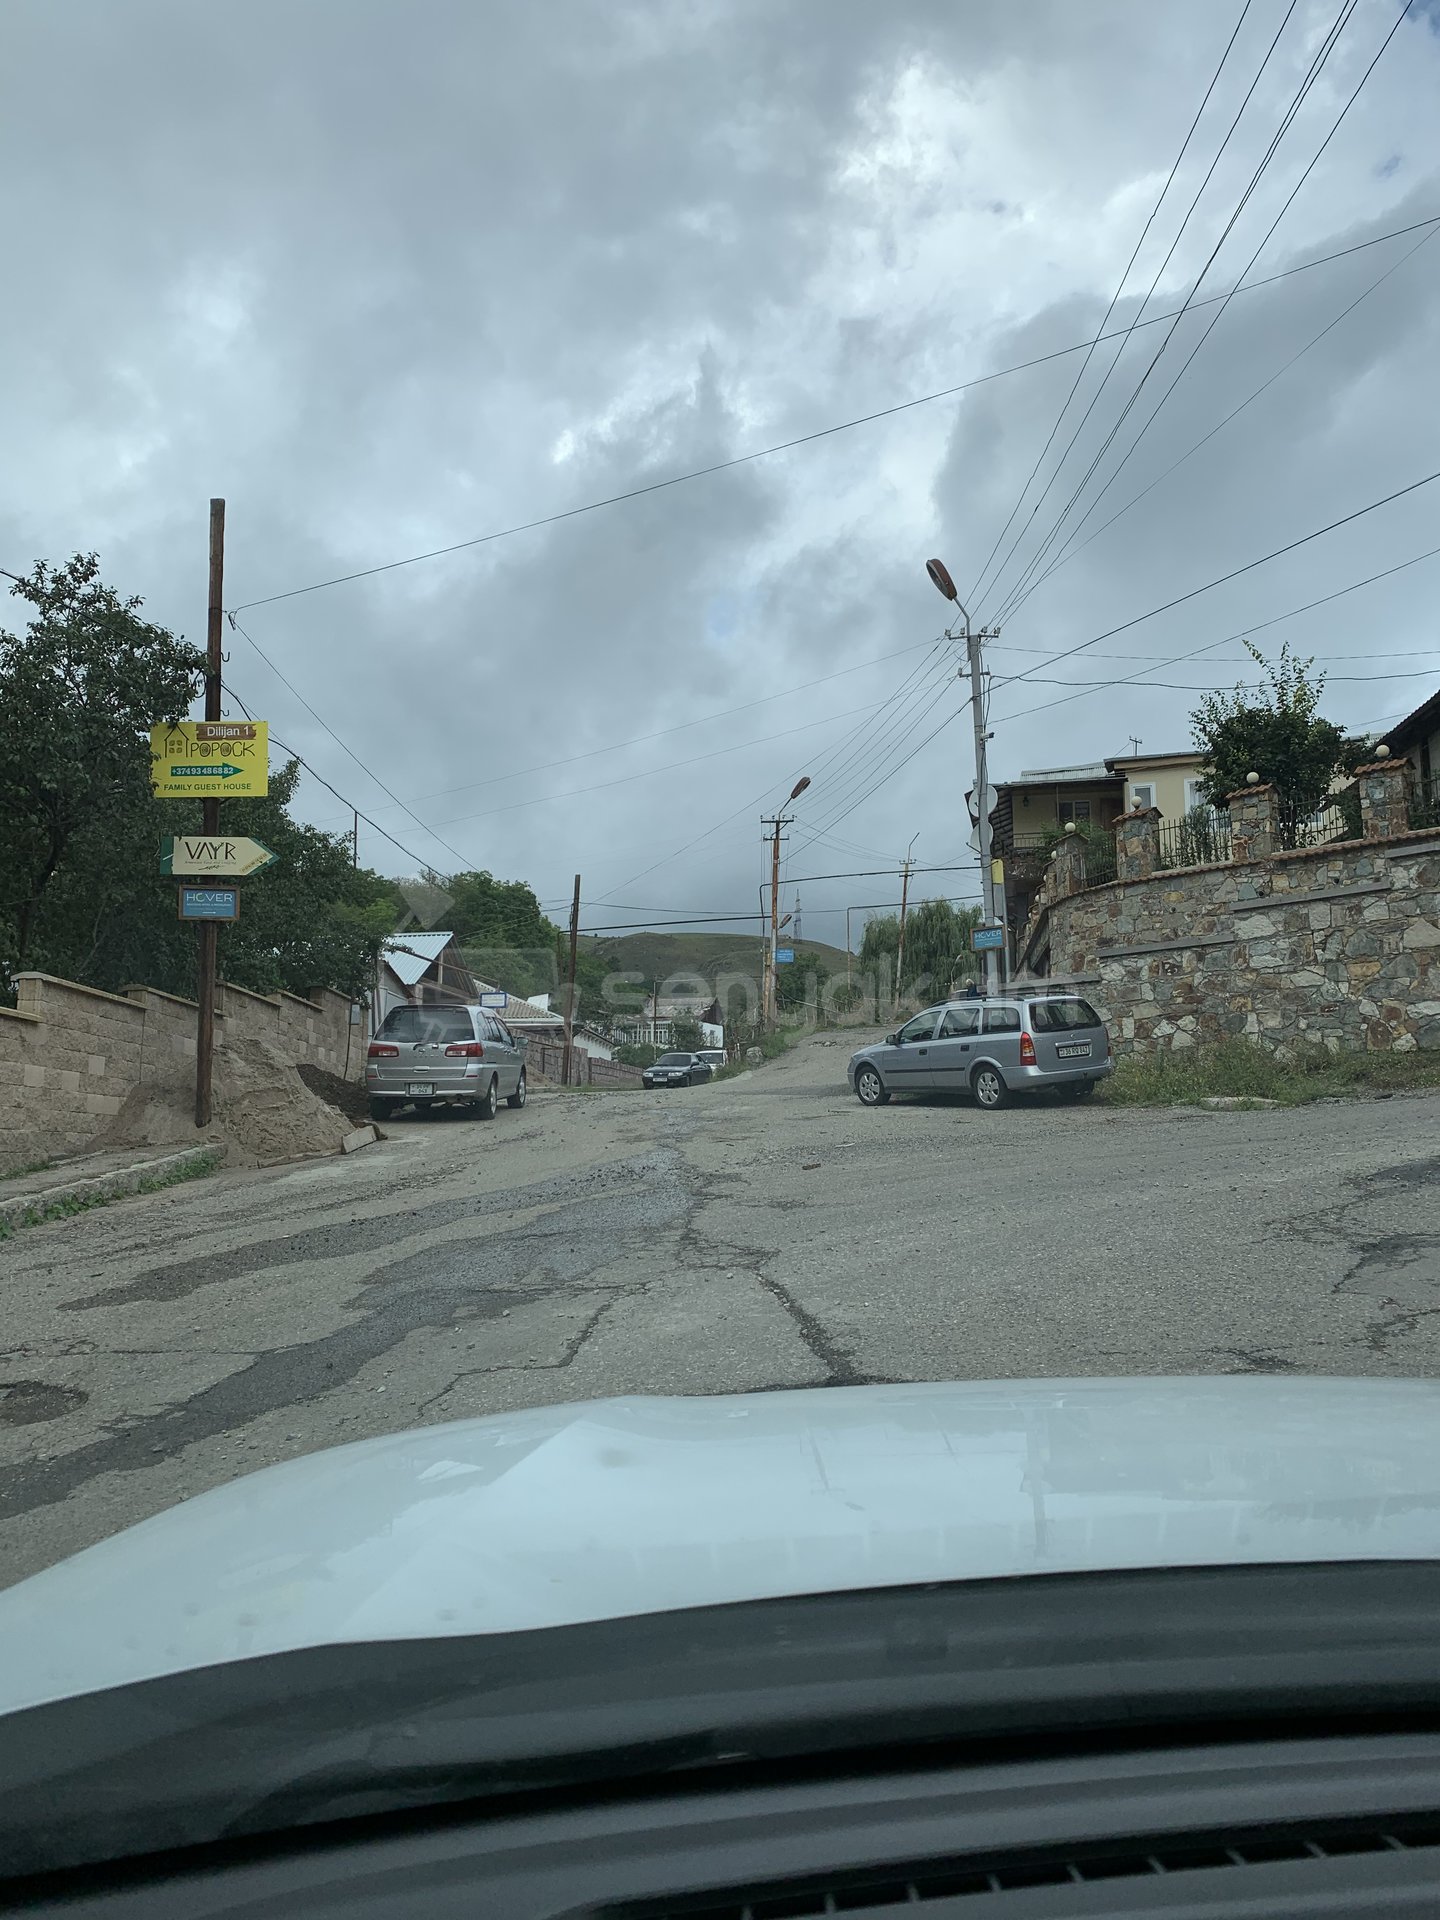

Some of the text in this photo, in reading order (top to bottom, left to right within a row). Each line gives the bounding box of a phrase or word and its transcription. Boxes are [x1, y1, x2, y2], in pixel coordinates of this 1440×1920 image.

[207, 726, 249, 738] Dilijan 1
[191, 741, 255, 758] POPOCK
[185, 842, 236, 860] VAYR
[186, 892, 233, 902] HOVER
